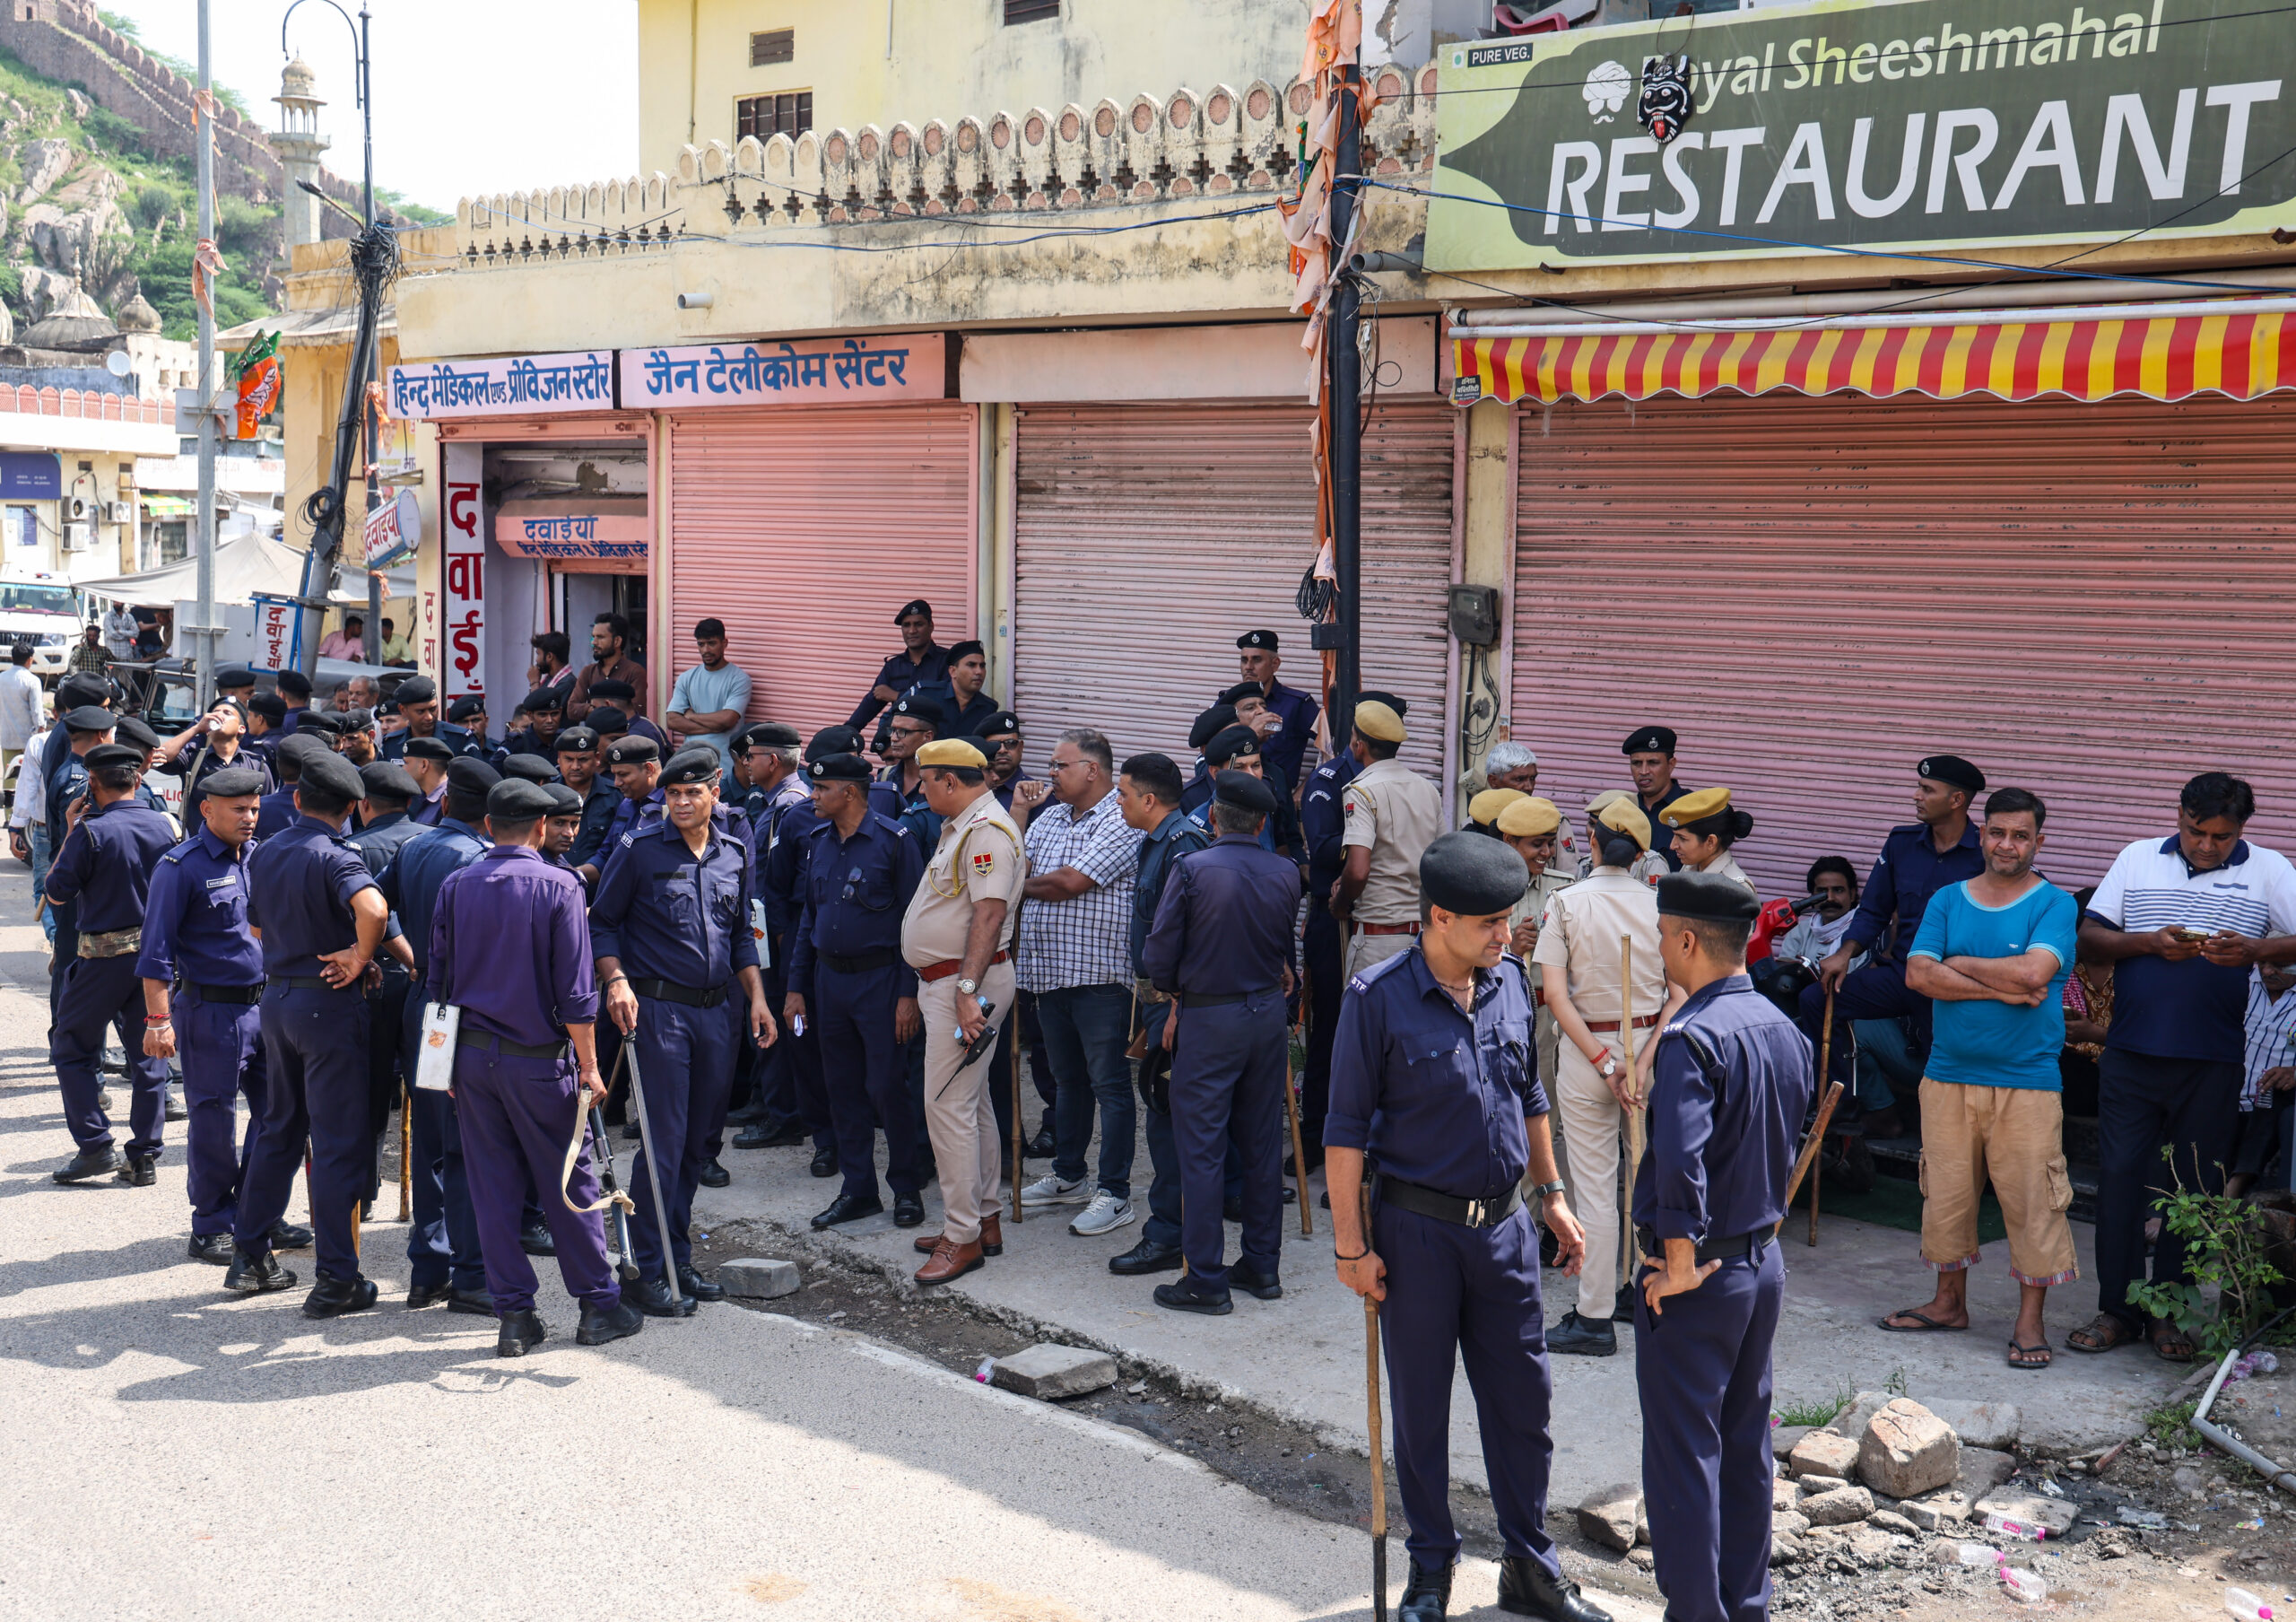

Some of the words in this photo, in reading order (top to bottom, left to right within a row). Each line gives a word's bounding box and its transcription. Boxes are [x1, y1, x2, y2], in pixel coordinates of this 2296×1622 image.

[1472, 49, 1501, 65] PURE
[1504, 47, 1530, 61] VEG.
[1639, 43, 1774, 115] yal
[1784, 0, 2165, 91] Sheeshmahal
[1544, 80, 2282, 234] RESTAURANT
[393, 368, 430, 416] हिन्द
[430, 364, 490, 407] मेडिकल
[507, 359, 571, 405] प्रोविजन
[573, 353, 611, 400] स्टोर
[643, 350, 700, 396] जैन
[705, 343, 830, 395] टेलीकोम
[833, 339, 909, 389] सेंटर
[897, 826, 909, 837] STF
[1171, 830, 1184, 842] STF
[1351, 976, 1367, 991] STF
